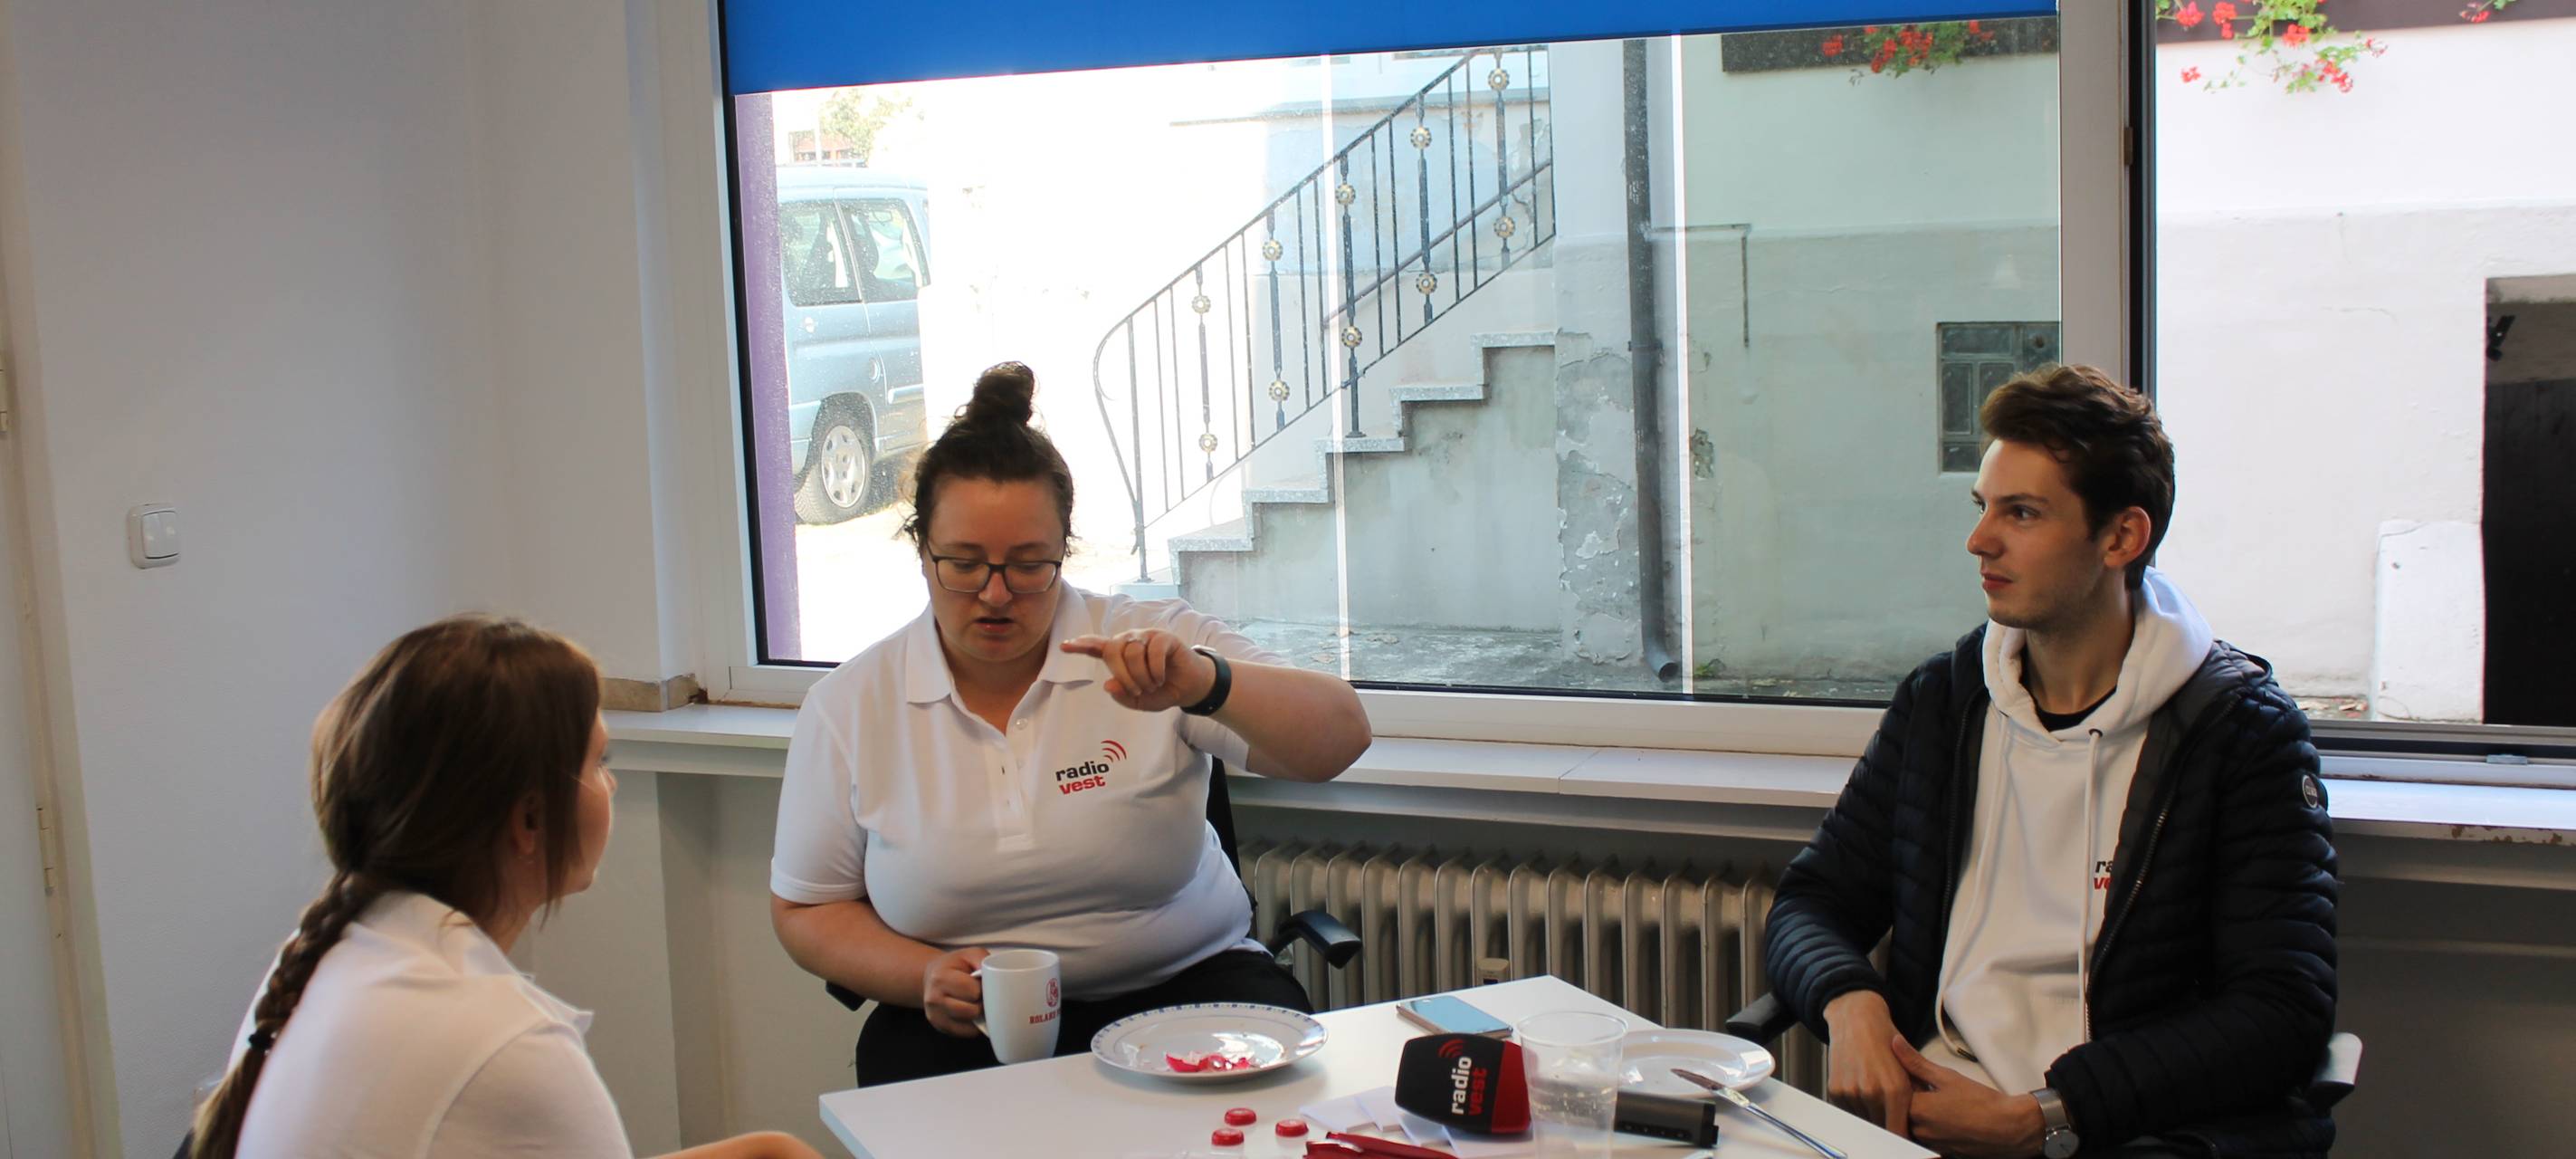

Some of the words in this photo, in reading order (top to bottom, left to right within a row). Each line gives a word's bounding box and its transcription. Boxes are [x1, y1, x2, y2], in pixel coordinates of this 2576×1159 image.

[1055, 761, 1110, 781] radio
[1059, 775, 1106, 795] vest
[1451, 1056, 1472, 1115] radio
[1468, 1068, 1487, 1116] vest
